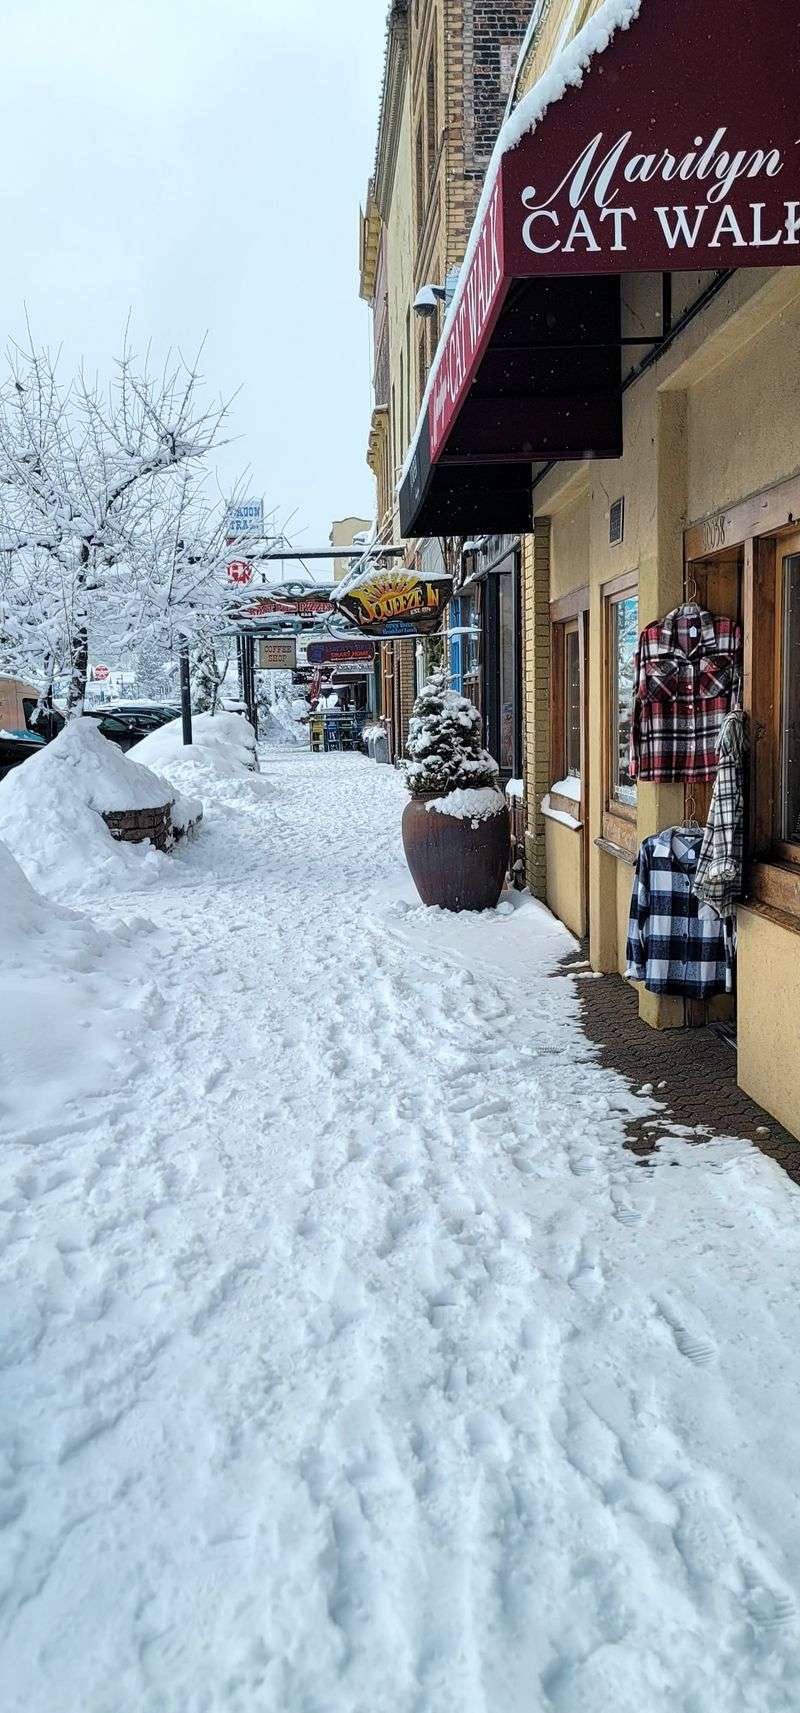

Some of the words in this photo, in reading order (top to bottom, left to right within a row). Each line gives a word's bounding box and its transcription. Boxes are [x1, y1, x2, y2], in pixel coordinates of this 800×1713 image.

[521, 127, 800, 210] Marilyn
[521, 206, 637, 254] CAT
[654, 201, 800, 250] WALK
[446, 305, 467, 404] CAT
[466, 186, 501, 354] WALK
[264, 645, 292, 653] COFFEE
